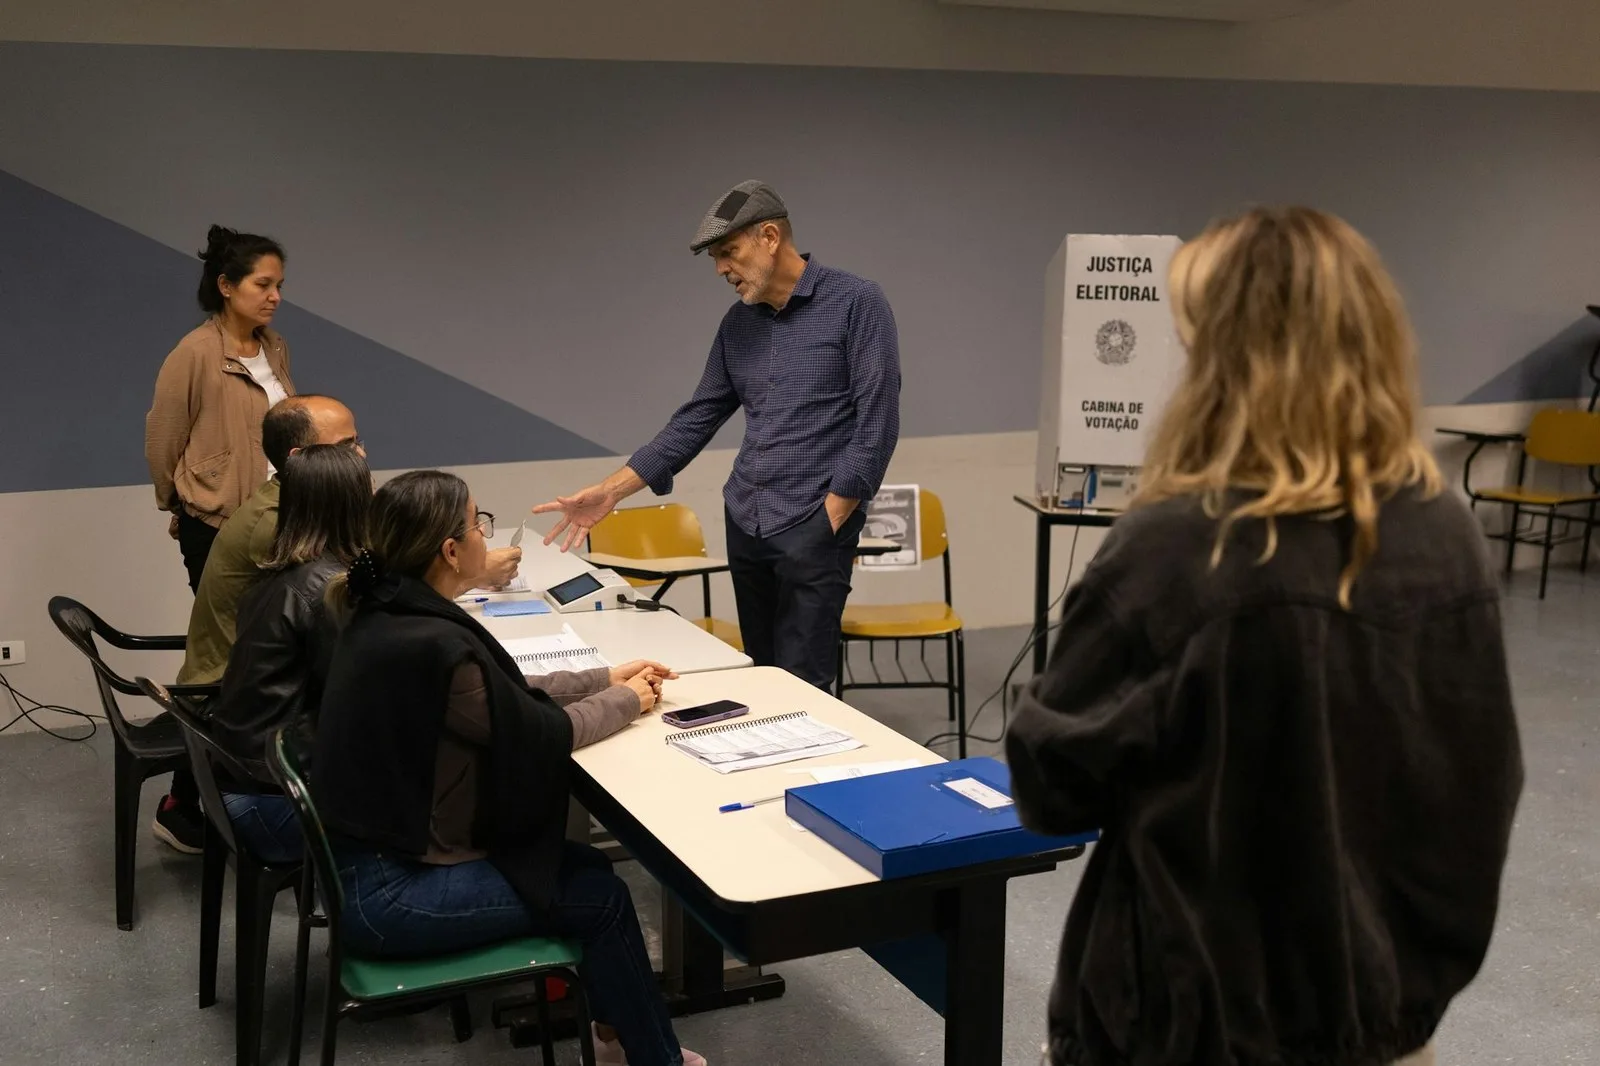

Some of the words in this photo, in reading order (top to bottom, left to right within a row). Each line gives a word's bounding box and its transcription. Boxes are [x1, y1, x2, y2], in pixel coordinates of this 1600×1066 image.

[1086, 256, 1153, 277] JUSTIÇA
[1076, 284, 1160, 302] ELEITORAL
[1081, 400, 1124, 413] CABINA
[1128, 402, 1144, 414] DE
[1085, 415, 1139, 432] VOTAÇÃO
